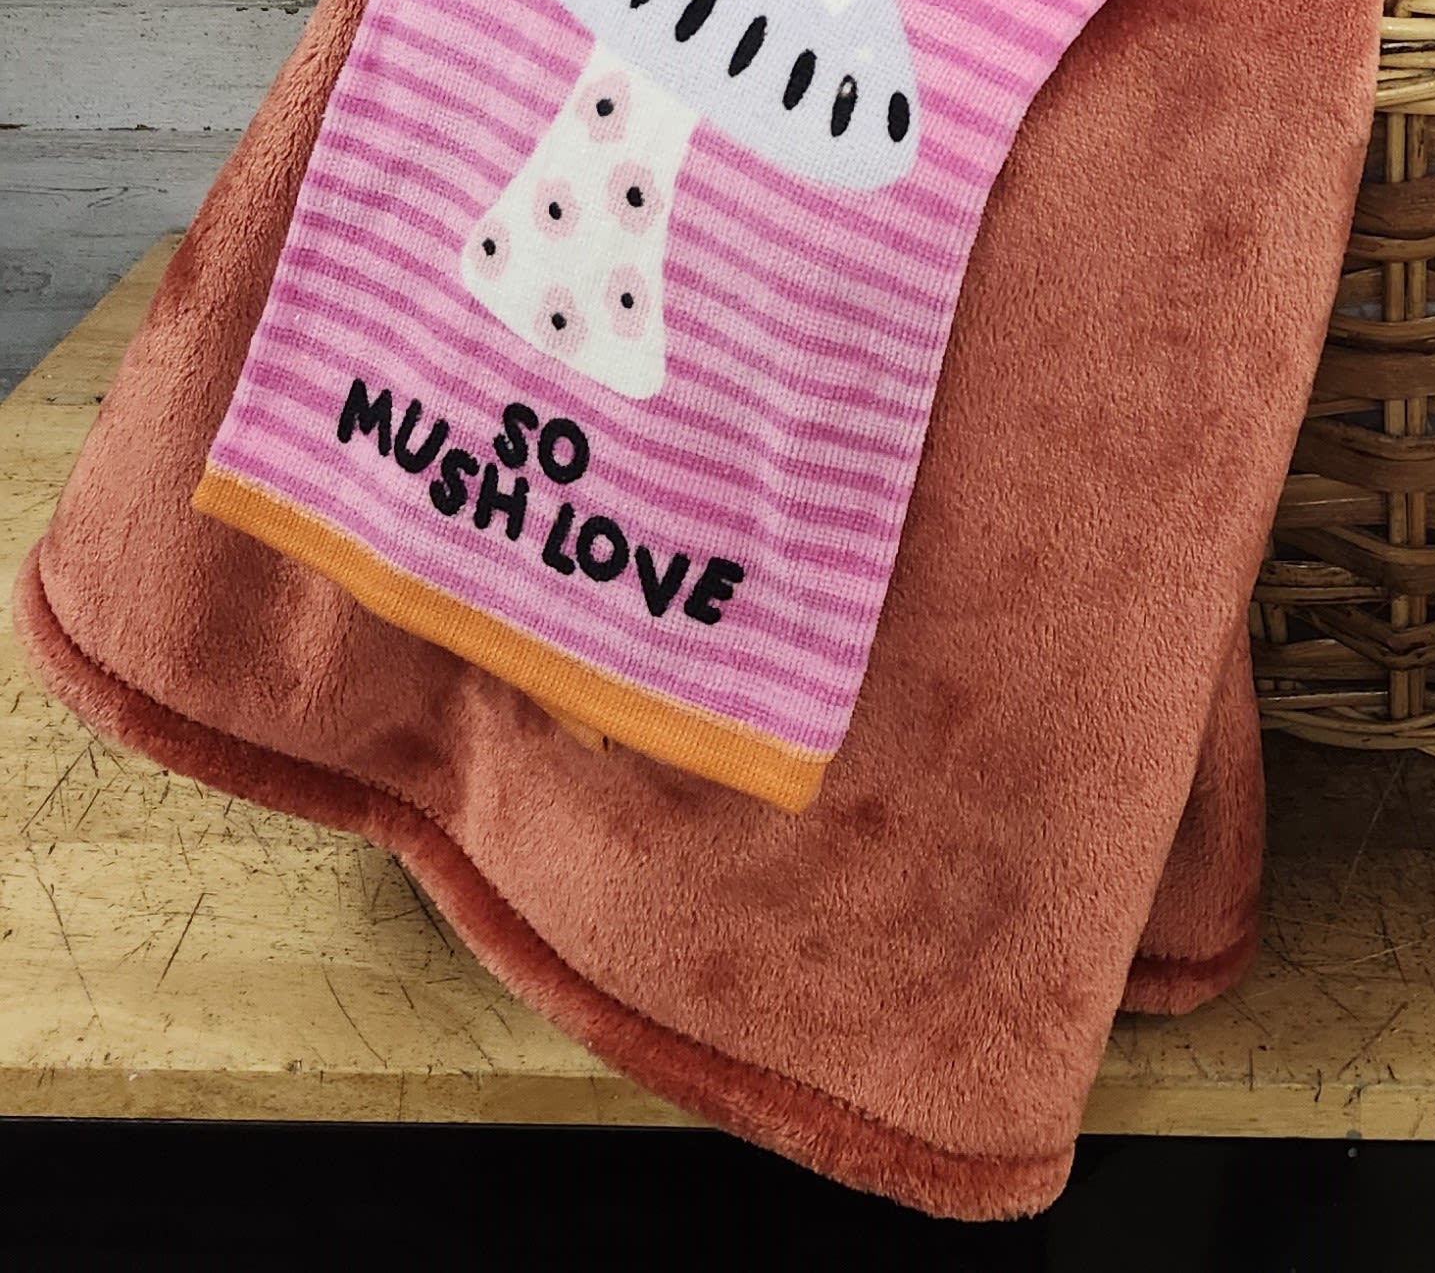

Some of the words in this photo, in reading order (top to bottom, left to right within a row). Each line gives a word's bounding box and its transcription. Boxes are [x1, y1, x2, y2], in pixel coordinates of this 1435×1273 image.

[337, 378, 529, 541] MUSH
[542, 503, 744, 625] LOVE
[493, 402, 590, 485] SO
